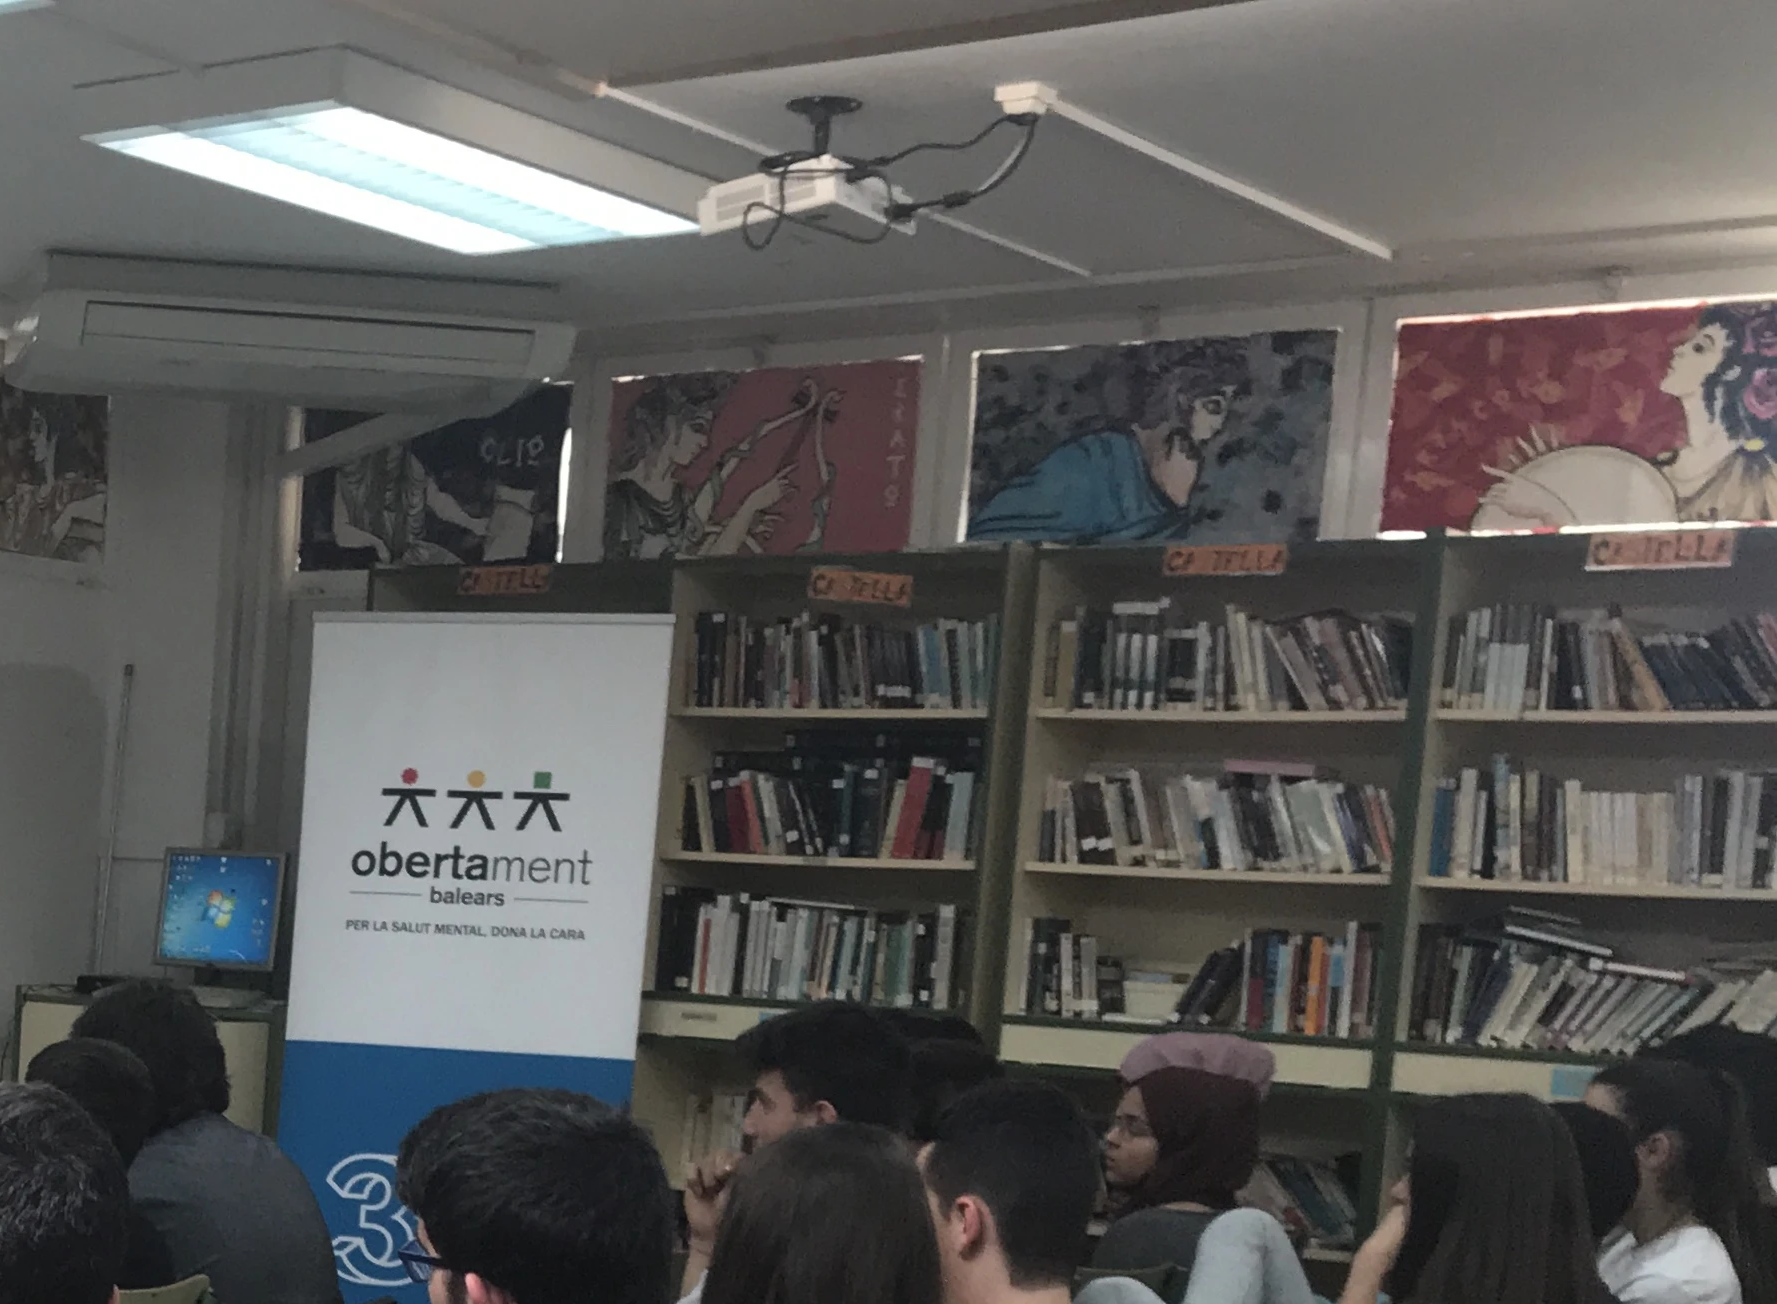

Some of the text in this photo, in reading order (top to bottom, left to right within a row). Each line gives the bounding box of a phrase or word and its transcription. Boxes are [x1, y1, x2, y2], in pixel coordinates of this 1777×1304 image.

[351, 841, 593, 886] obertament
[429, 886, 505, 907] balears
[345, 919, 370, 931] PER
[372, 920, 389, 932] LA
[391, 921, 431, 934] SALUT
[491, 925, 527, 938] DONA
[530, 927, 547, 940] LA
[549, 928, 586, 941] CARA
